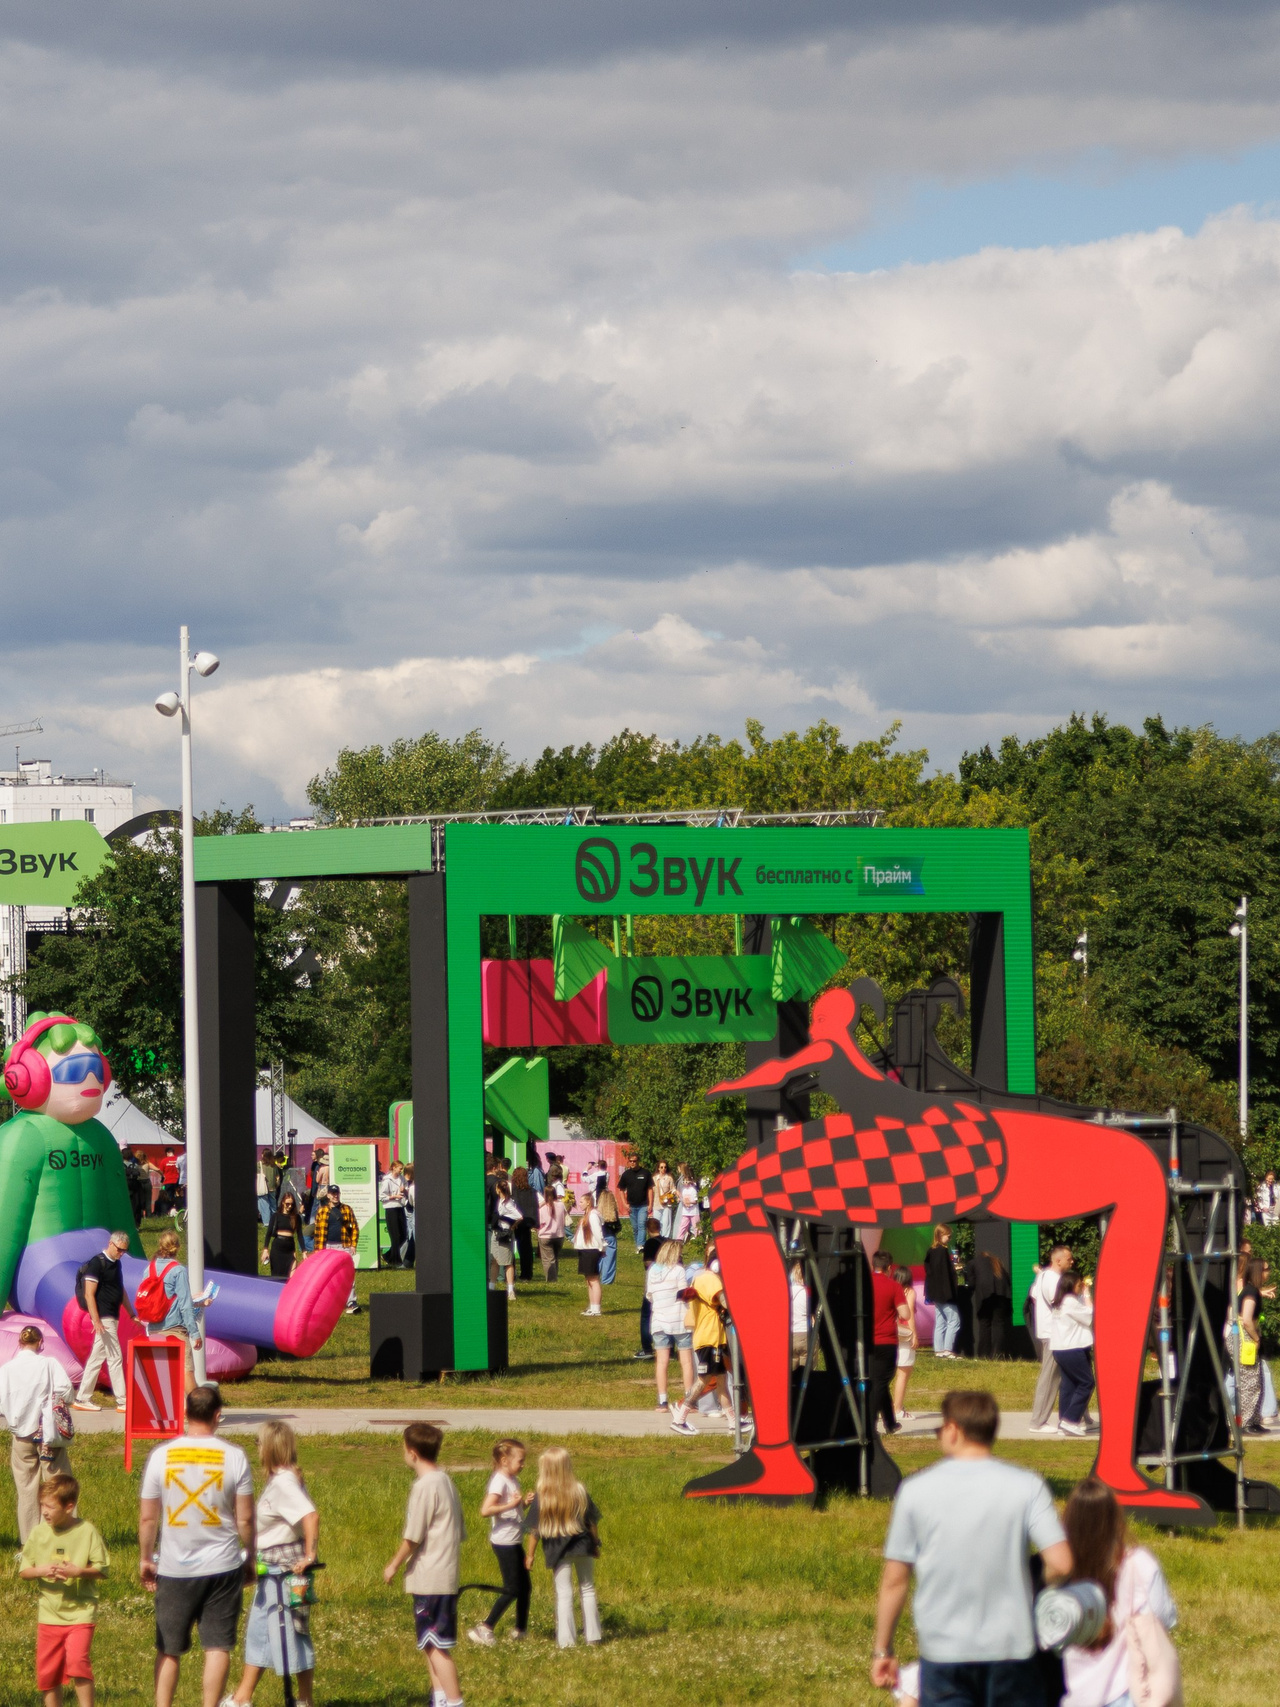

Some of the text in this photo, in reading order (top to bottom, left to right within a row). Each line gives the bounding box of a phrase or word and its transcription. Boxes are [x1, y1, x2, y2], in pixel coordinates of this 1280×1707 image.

[629, 842, 912, 907] Звук бесплатно с Прайм
[671, 978, 754, 1024] Звук
[70, 1150, 104, 1170] Звук
